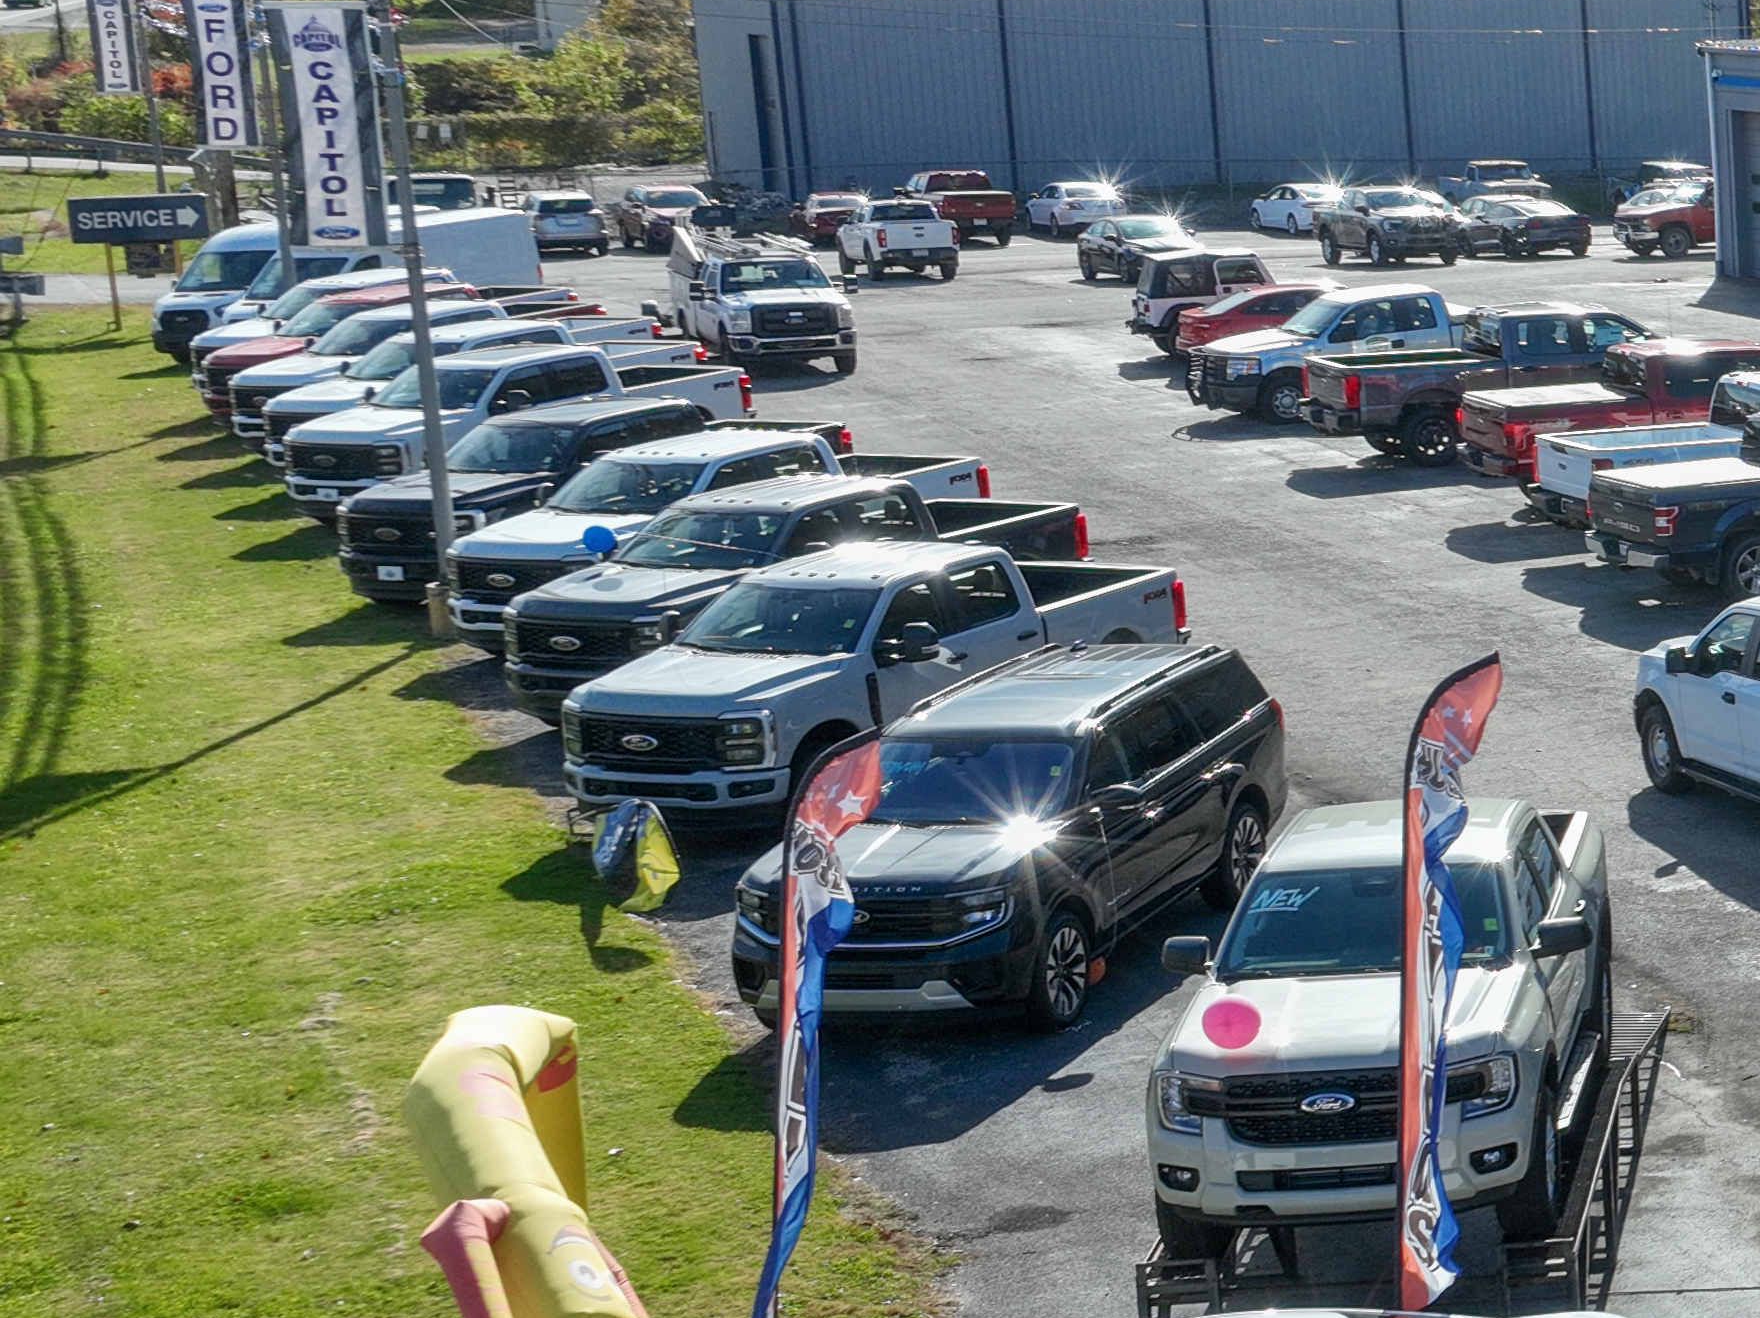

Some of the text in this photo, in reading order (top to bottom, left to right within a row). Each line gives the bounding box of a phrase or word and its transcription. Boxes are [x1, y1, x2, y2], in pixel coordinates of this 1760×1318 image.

[103, 10, 122, 79] CAPITOL
[204, 19, 239, 141] FORD
[308, 61, 348, 217] CAPITOL
[77, 209, 173, 230] SERVICE
[1251, 886, 1321, 909] NEW
